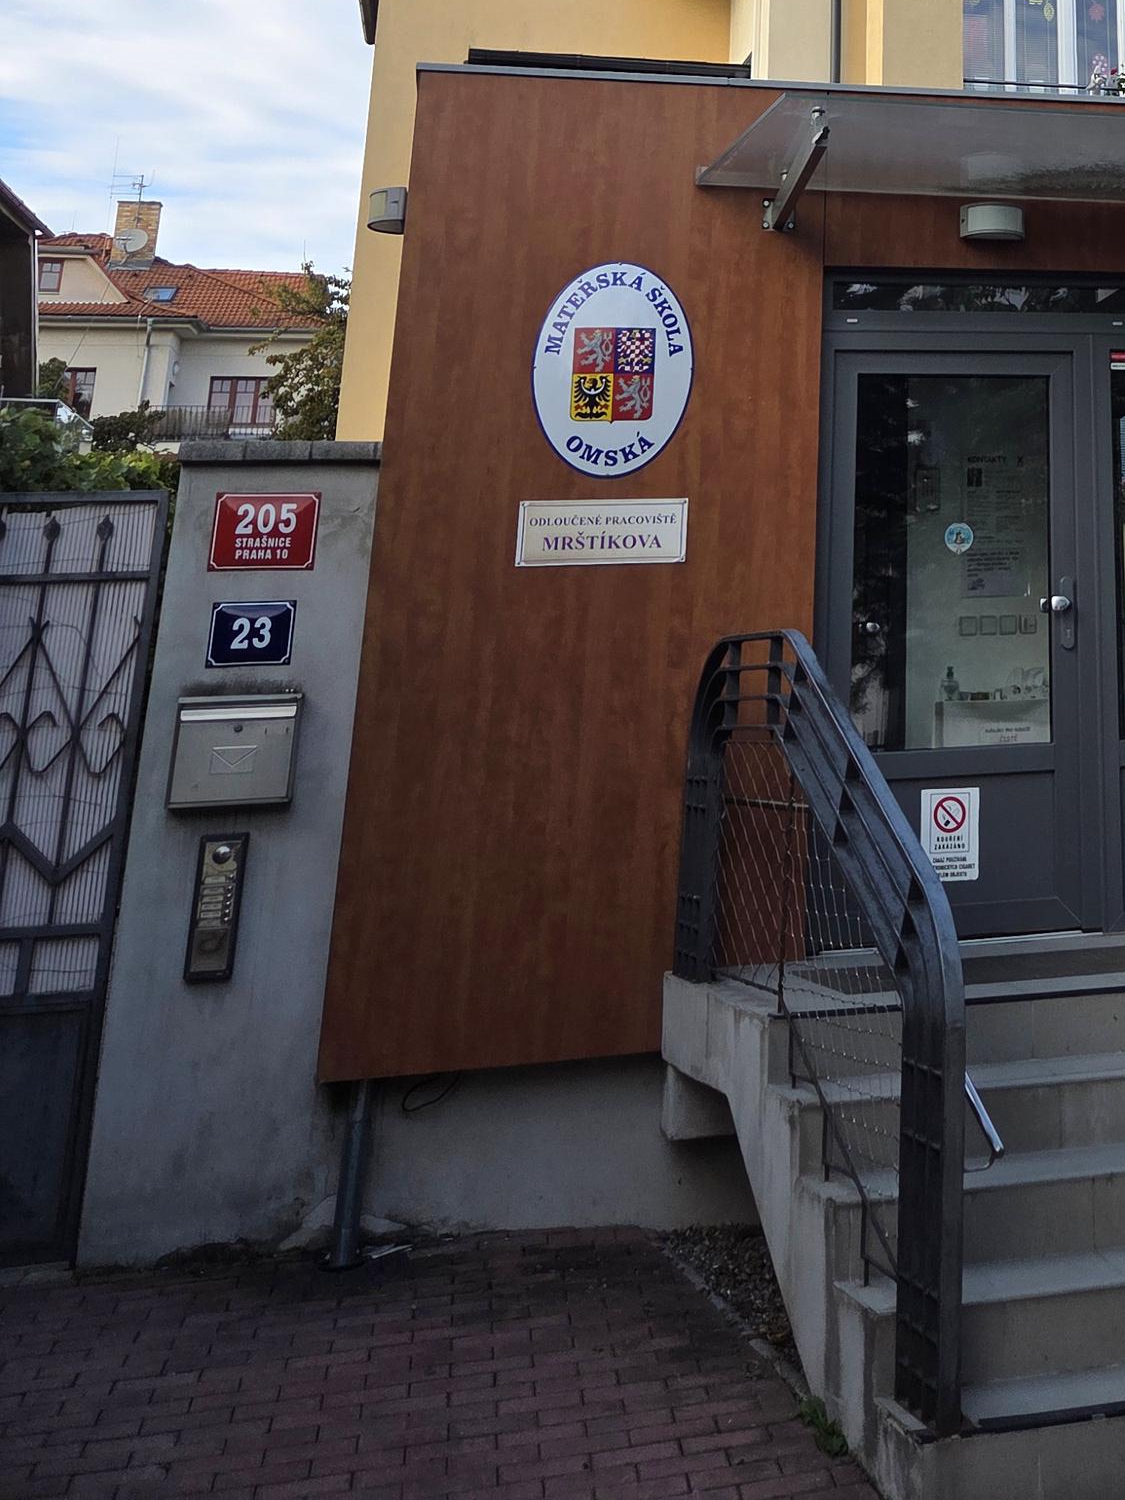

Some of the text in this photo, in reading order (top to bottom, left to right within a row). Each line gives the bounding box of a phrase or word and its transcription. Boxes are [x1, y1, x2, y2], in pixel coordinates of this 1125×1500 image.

[545, 271, 684, 357] MATEŘSKÁ ŠKOLA
[565, 431, 655, 467] OMSKÁ
[234, 503, 297, 534] 205
[529, 512, 677, 527] ODLOUČENÉ PRACOVIŠTĚ
[235, 535, 292, 548] STRAŠNICE
[541, 530, 663, 551] MRŠTÍKOVA
[235, 549, 289, 560] PRAHA 10
[230, 616, 273, 650] 23
